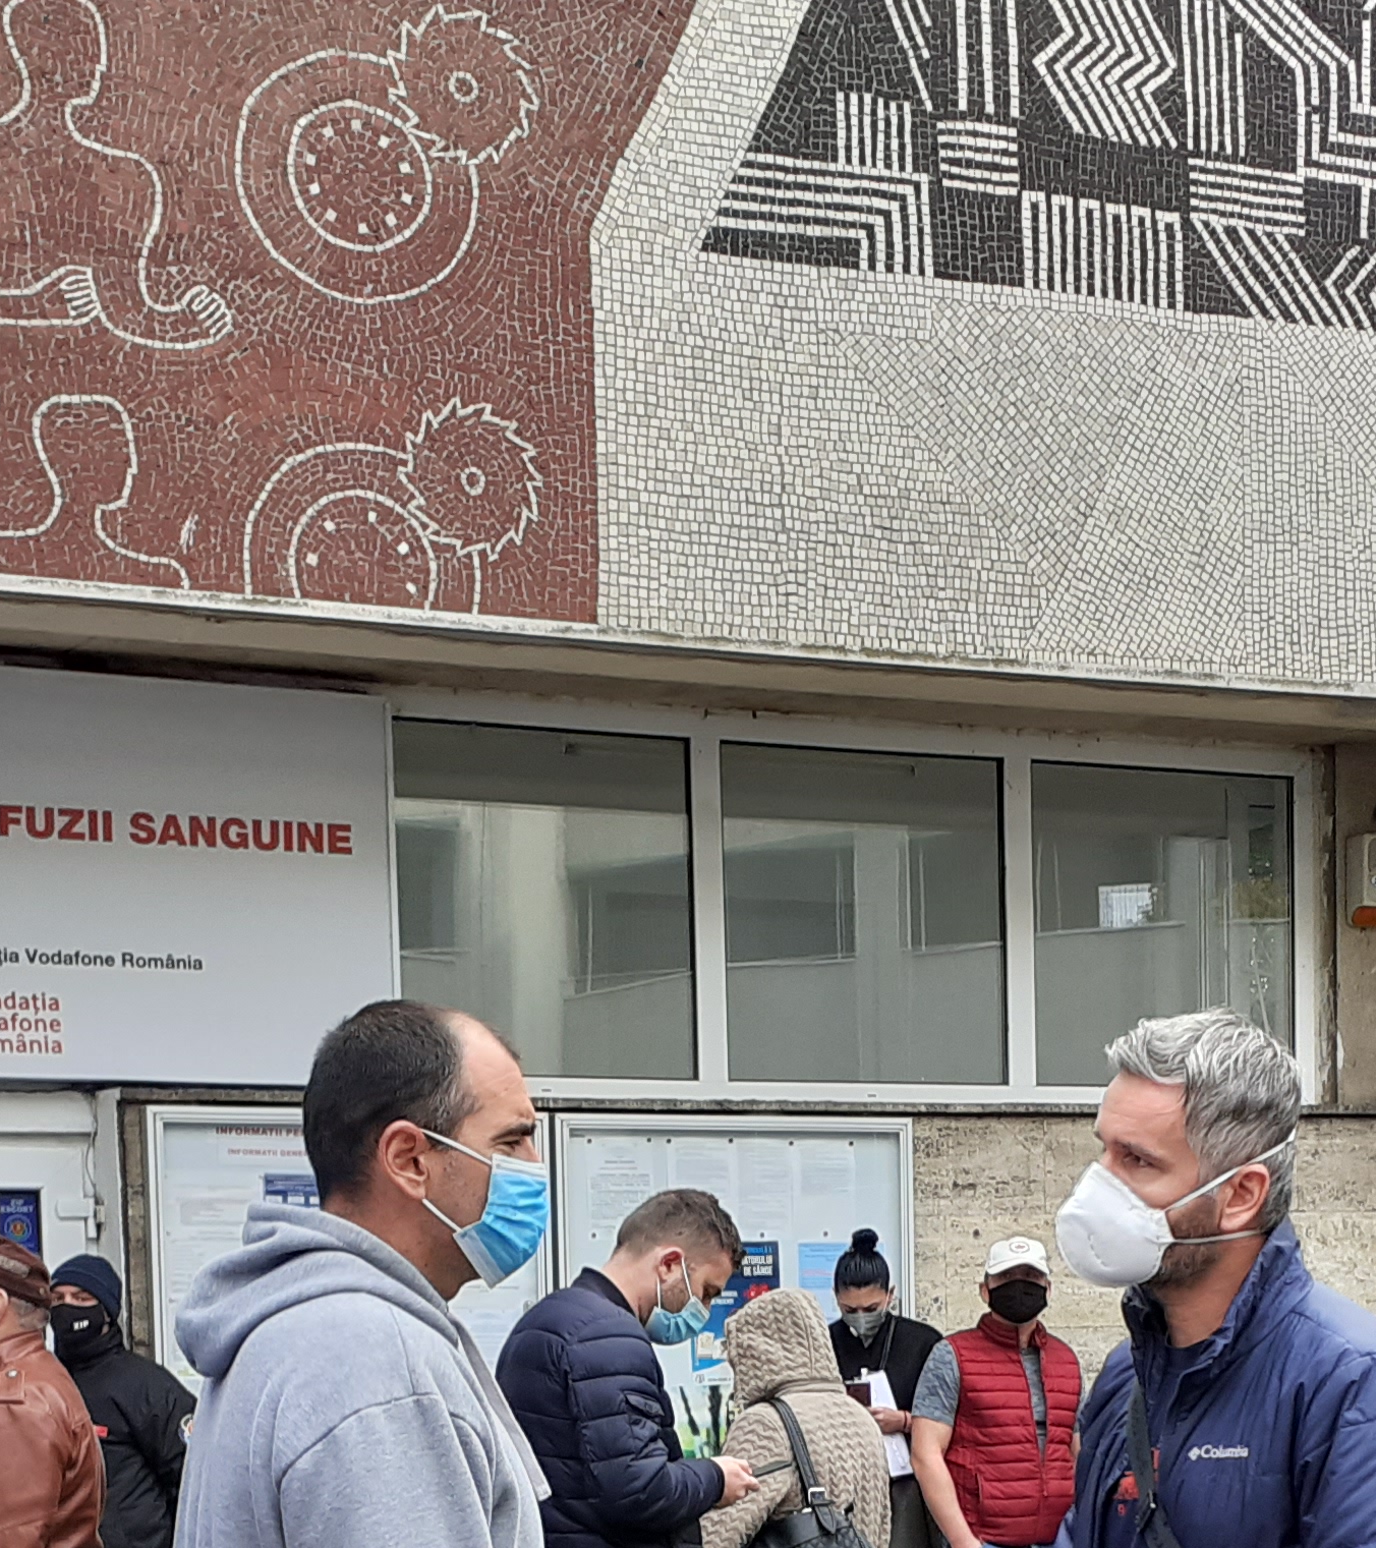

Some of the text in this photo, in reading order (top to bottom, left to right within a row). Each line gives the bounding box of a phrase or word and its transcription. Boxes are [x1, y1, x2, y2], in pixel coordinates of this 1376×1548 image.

[129, 812, 353, 855] SANGUINE
[25, 948, 115, 968] Vodafone
[121, 952, 203, 971] România
[1200, 1444, 1249, 1458] Columbia
